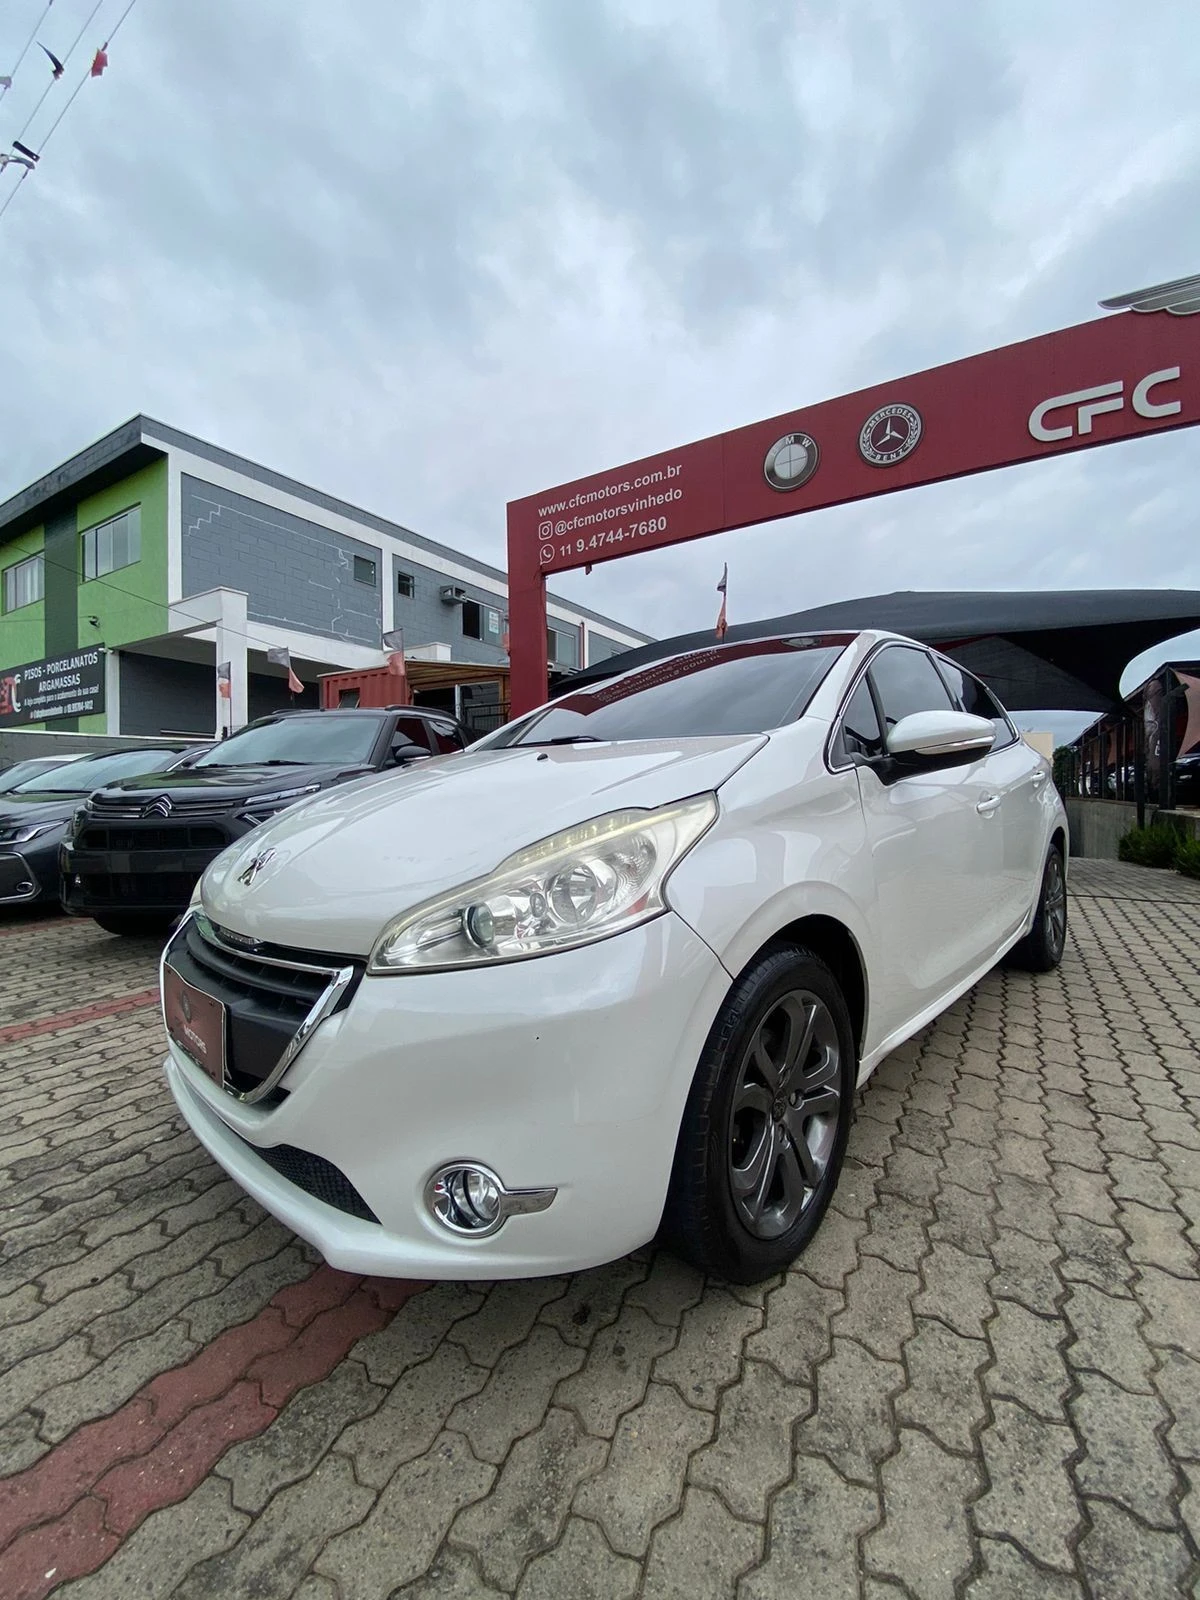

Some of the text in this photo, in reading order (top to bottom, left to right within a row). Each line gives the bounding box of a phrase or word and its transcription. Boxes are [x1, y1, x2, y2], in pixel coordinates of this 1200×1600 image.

[869, 407, 912, 428] MERCEDES
[1028, 366, 1181, 442] CFC
[538, 463, 682, 517] www.cfcmotors.com.br
[555, 488, 683, 536] @cfcmotorsvinhedo
[559, 516, 667, 557] 11 9.4744-7680
[24, 666, 42, 681] PISOS
[46, 651, 98, 675] PORCELANATOS
[38, 673, 81, 693] ARGAMASSAS
